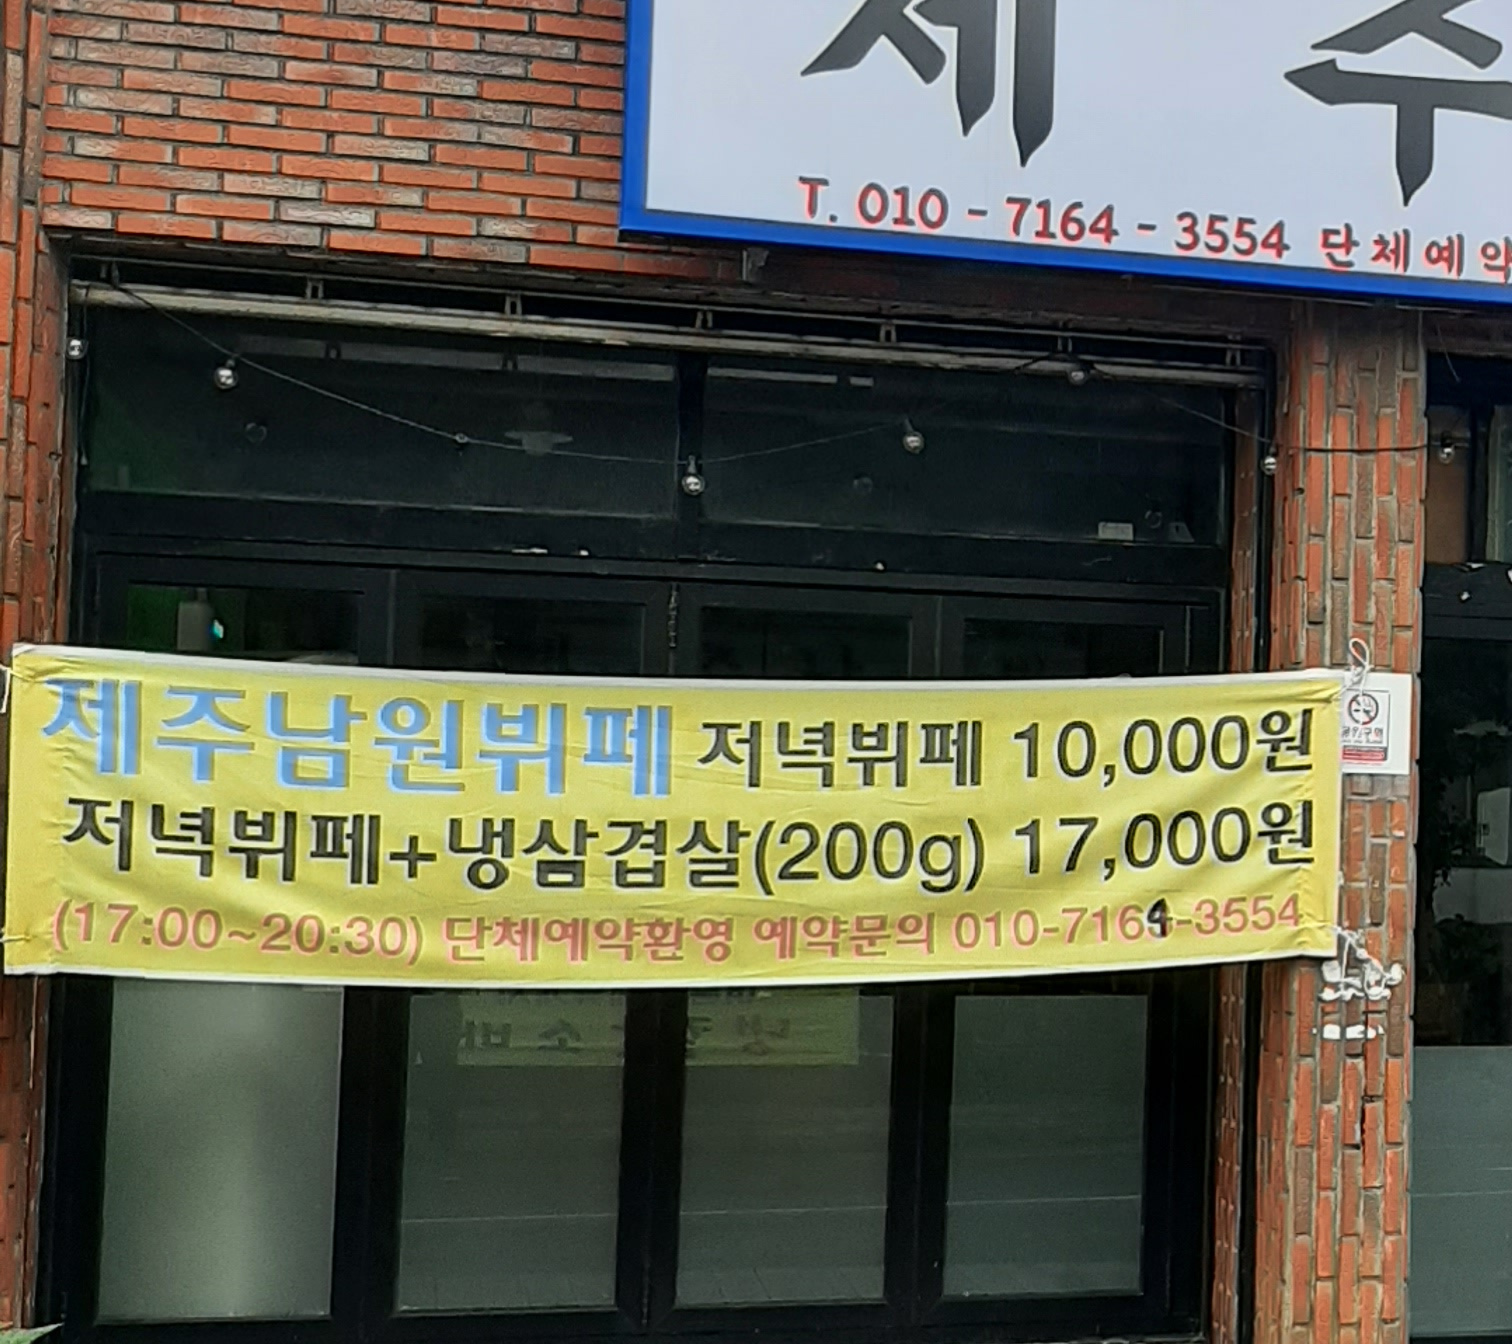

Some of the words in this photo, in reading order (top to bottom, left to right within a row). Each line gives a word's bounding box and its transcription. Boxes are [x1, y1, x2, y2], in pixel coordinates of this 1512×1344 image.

[42, 678, 673, 799] 제주남원뷔페
[698, 720, 983, 788] 저녁뷔페
[1013, 708, 1314, 789] 10,000원
[1014, 799, 1315, 881] 17,000원
[52, 899, 425, 967] (17:00~20:30)
[442, 914, 734, 964] 단체예약환영
[752, 912, 936, 961] 예약문의
[951, 892, 1303, 953] 010-7164-3554
